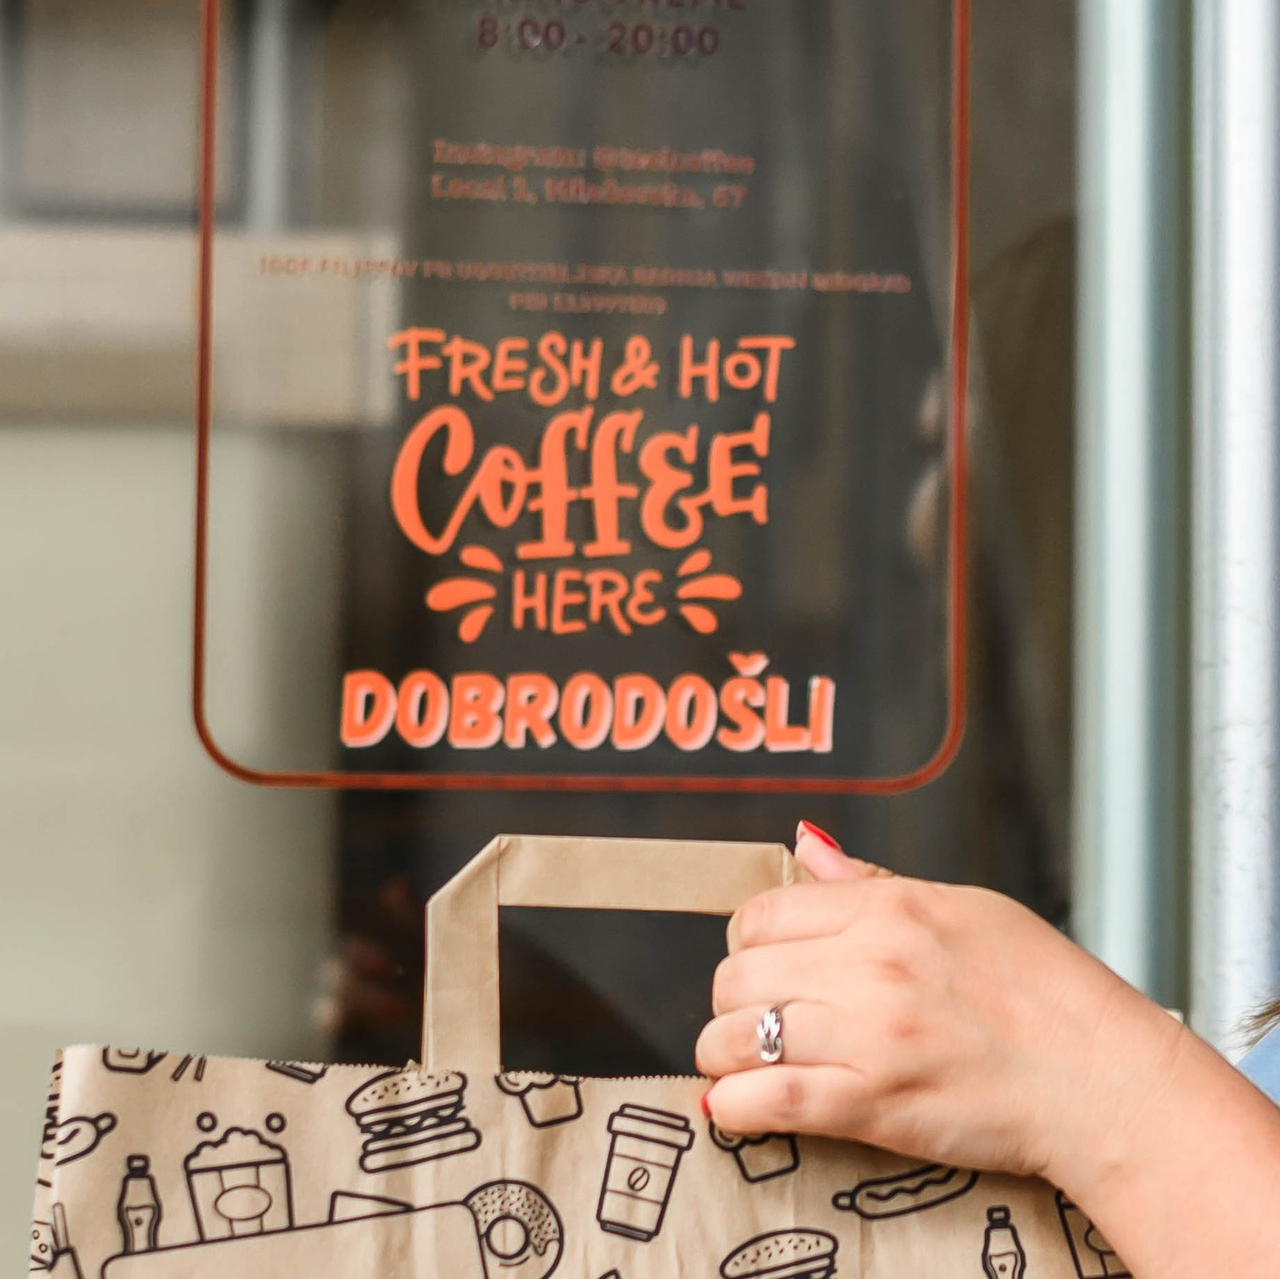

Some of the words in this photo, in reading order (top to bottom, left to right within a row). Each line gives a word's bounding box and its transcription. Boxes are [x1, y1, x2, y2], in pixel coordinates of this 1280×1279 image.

[606, 22, 721, 57] 20:00
[389, 327, 604, 406] FRESH
[611, 335, 661, 398] &
[679, 335, 797, 403] HOT
[511, 568, 668, 636] HERE
[339, 652, 836, 754] DOBRODOŠLI
